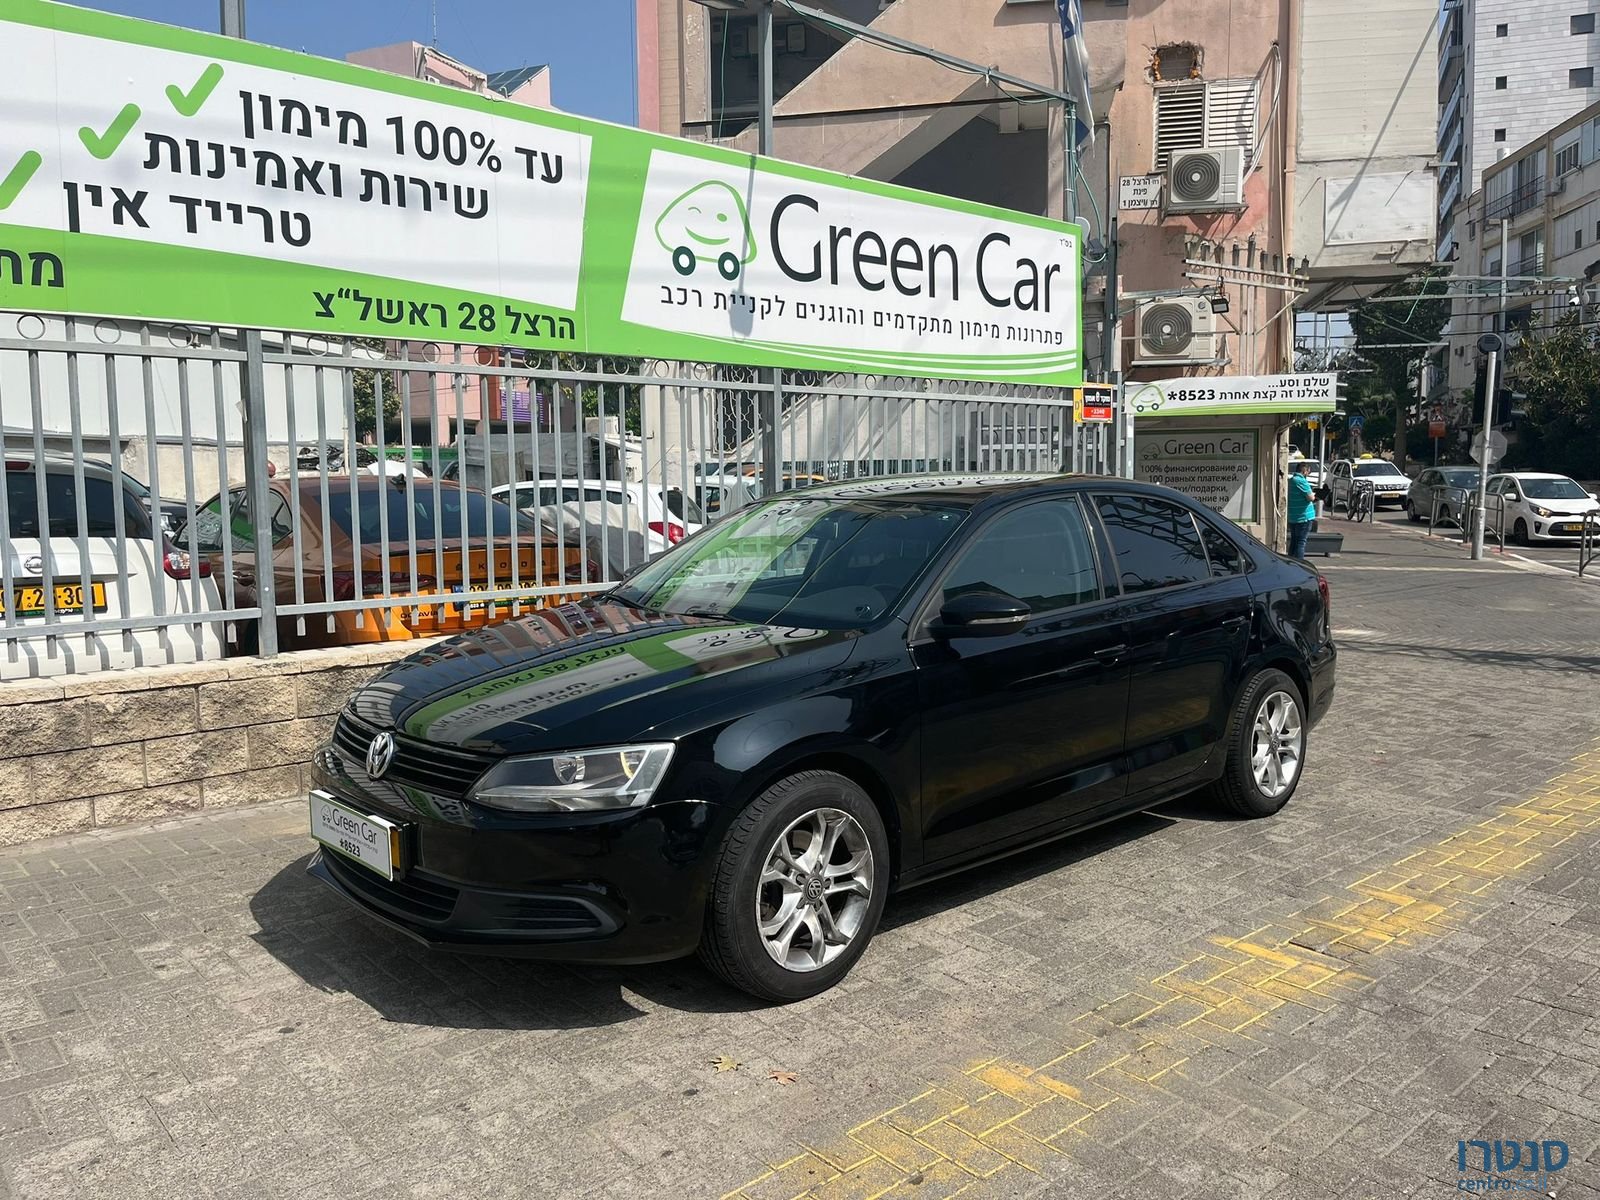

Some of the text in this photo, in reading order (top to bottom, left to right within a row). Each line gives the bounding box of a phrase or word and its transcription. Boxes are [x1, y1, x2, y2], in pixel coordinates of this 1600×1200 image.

[239, 90, 563, 184] עד 100% מימון
[143, 132, 489, 219] שירות ואמינות
[63, 181, 311, 247] טרייד אין
[770, 194, 1060, 313] Green Car
[457, 301, 496, 332] 28
[504, 304, 576, 340] הרצל
[661, 285, 1063, 345] פתרונות מימון מתקדמים והוגנים לקניית רכב
[1281, 389, 1293, 398] זה
[1297, 388, 1329, 398] אצלנו
[1303, 377, 1329, 387] שלם
[1219, 391, 1250, 400] אחרת
[1253, 389, 1277, 400] קצת
[1164, 438, 1249, 455] Green Car
[1141, 465, 1162, 473] 100%
[1163, 464, 1235, 474] финансирование
[1164, 475, 1196, 483] равных
[332, 808, 360, 836] Green
[361, 822, 377, 844] Car
